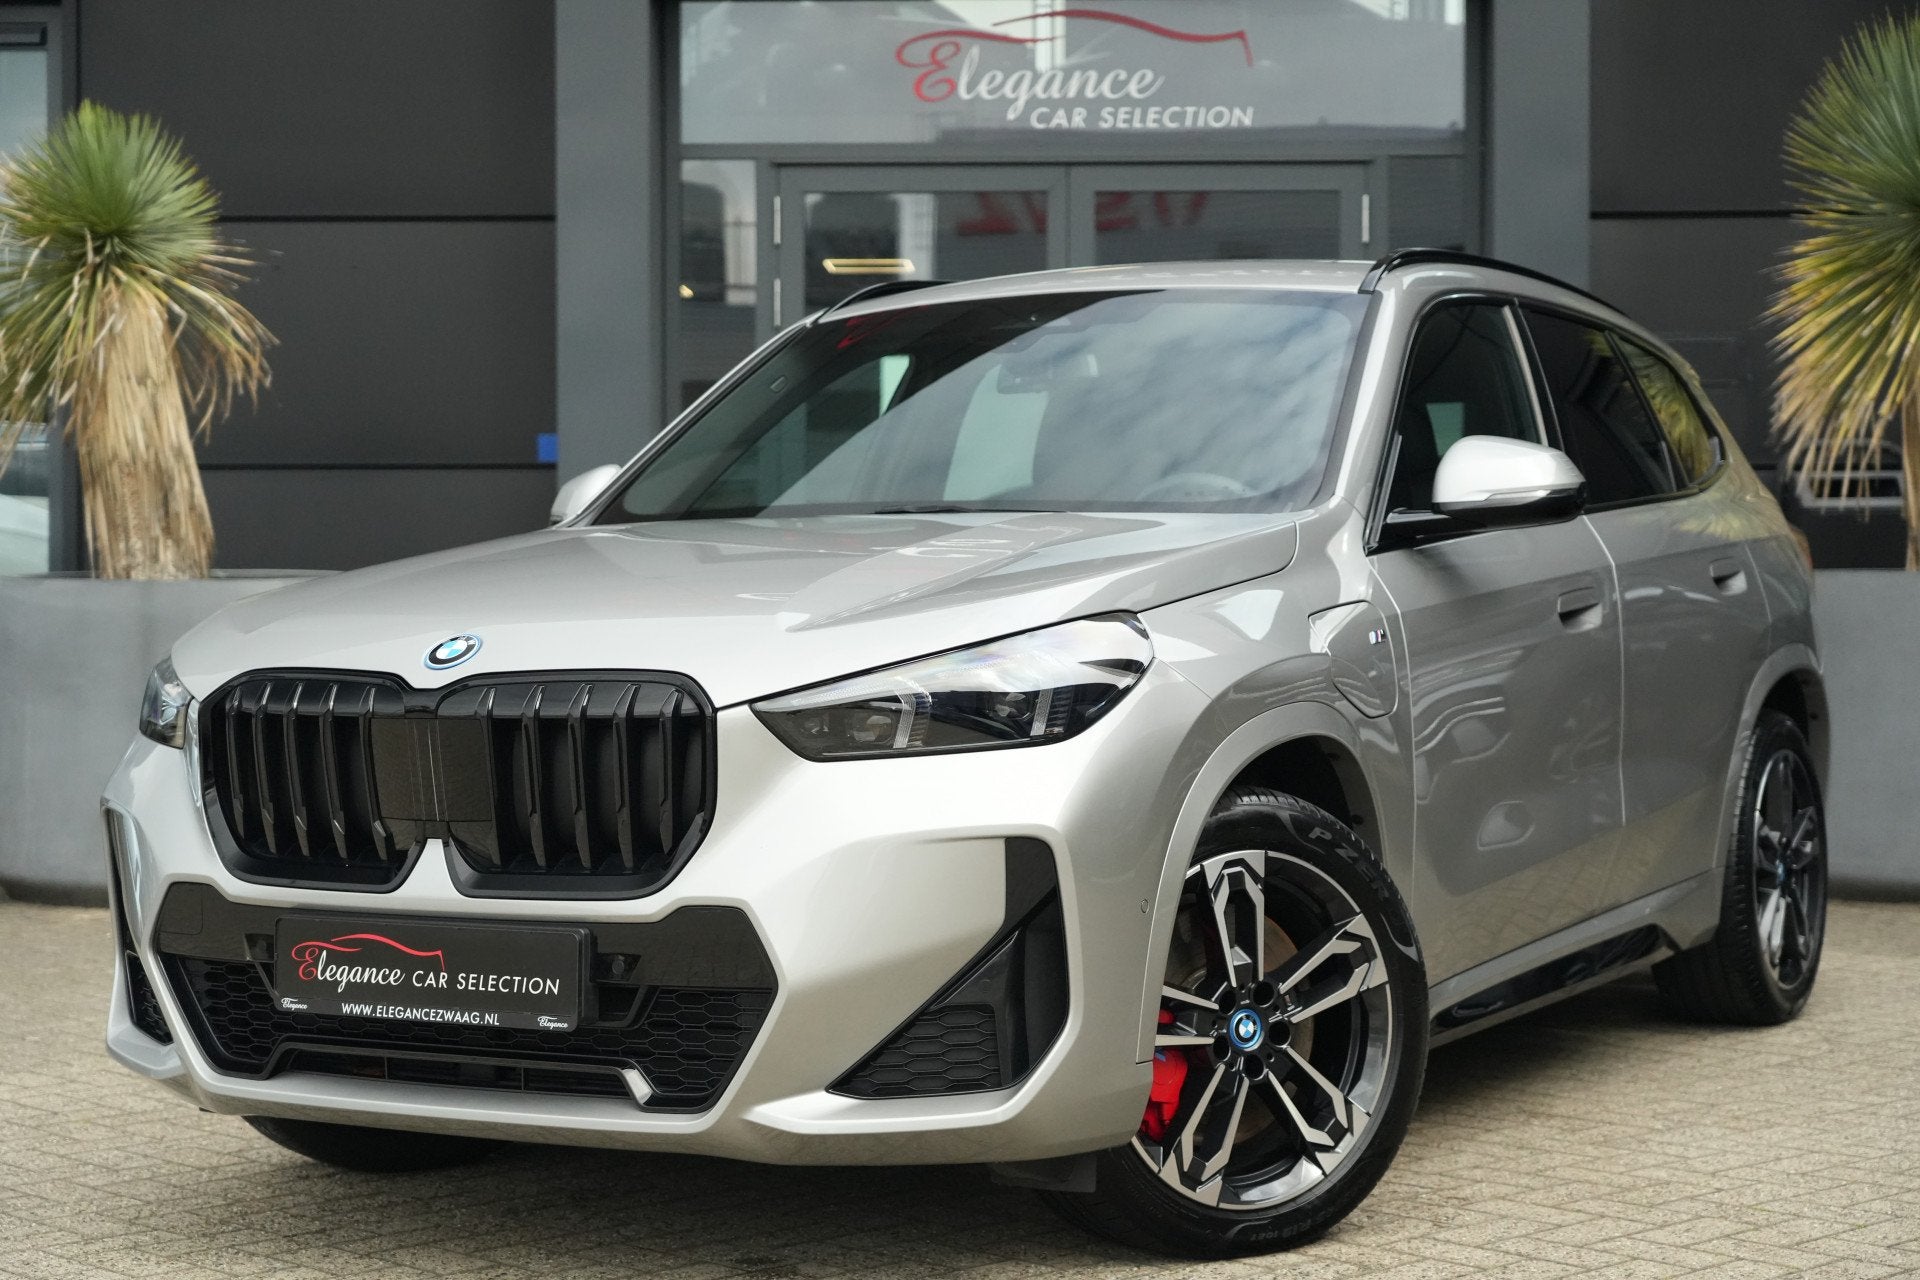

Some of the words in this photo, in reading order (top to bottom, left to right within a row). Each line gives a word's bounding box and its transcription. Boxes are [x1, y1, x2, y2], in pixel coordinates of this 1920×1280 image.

[895, 30, 1165, 121] Elegance
[1030, 106, 1088, 129] CAR
[1099, 105, 1254, 128] SELECTION
[1308, 827, 1333, 840] P
[291, 941, 405, 993] Elegance
[412, 970, 448, 989] CAR
[457, 972, 560, 995] SELECTION
[281, 997, 308, 1011] Elegance
[341, 1002, 500, 1026] WWW.ELEGANCEZWAAG.NL
[537, 1015, 569, 1030] Elegance
